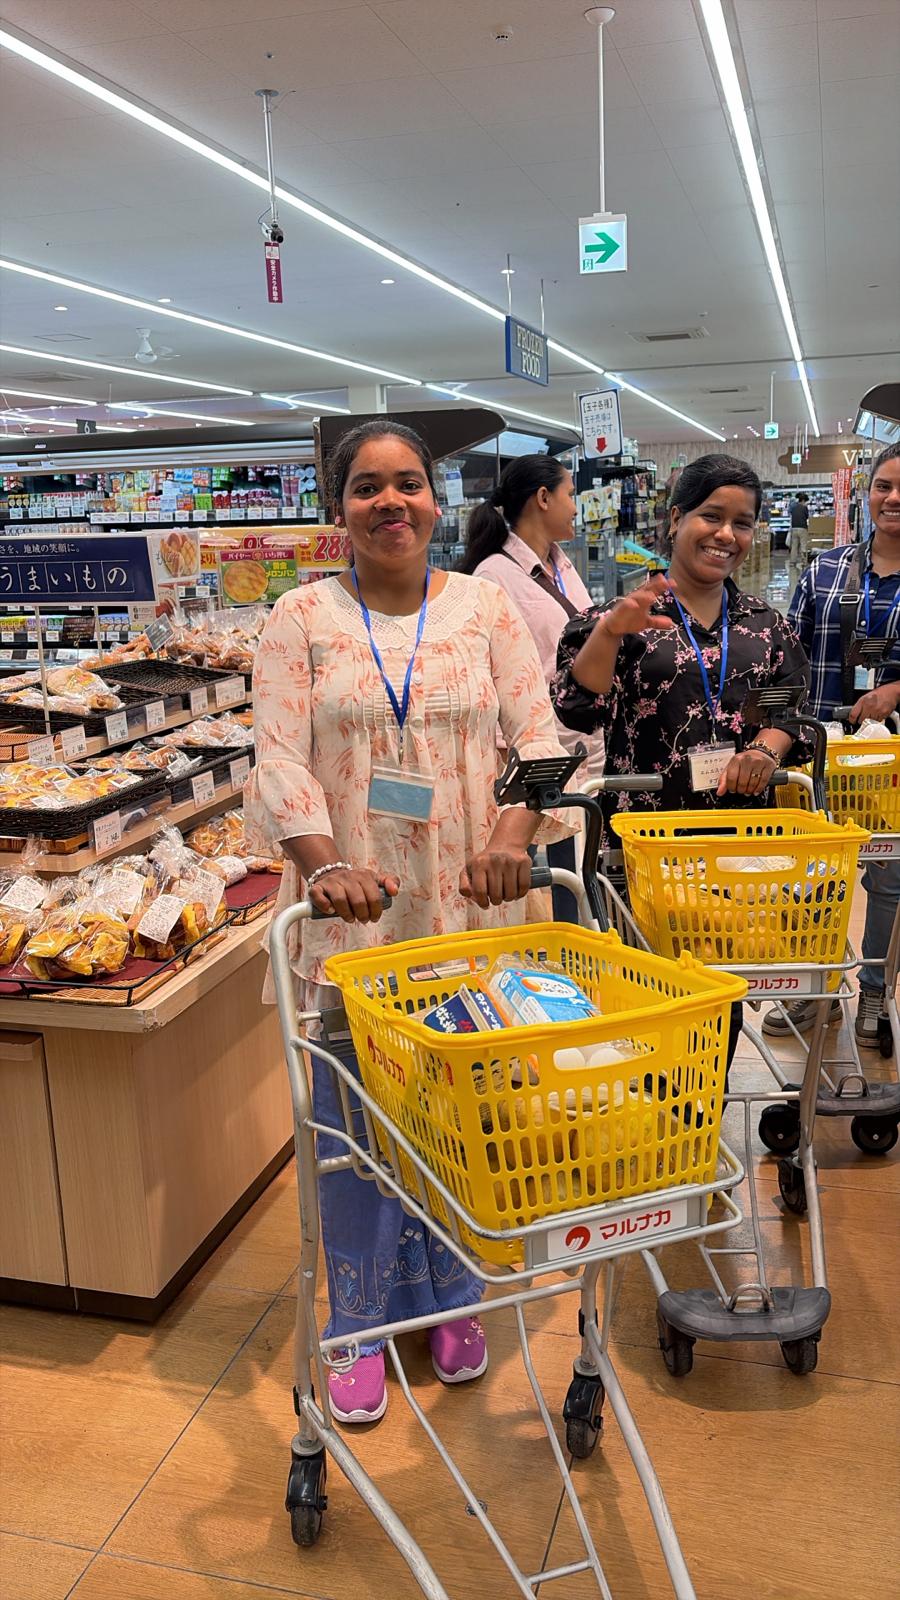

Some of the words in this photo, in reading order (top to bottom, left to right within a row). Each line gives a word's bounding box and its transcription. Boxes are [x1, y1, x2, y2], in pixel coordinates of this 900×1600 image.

[516, 325, 544, 358] FROZEN
[521, 351, 541, 378] FOOD
[0, 564, 127, 591] うまいもの
[265, 569, 296, 577] メロンパン
[374, 1045, 406, 1088] マルナカ
[599, 1209, 671, 1240] マルナカ
